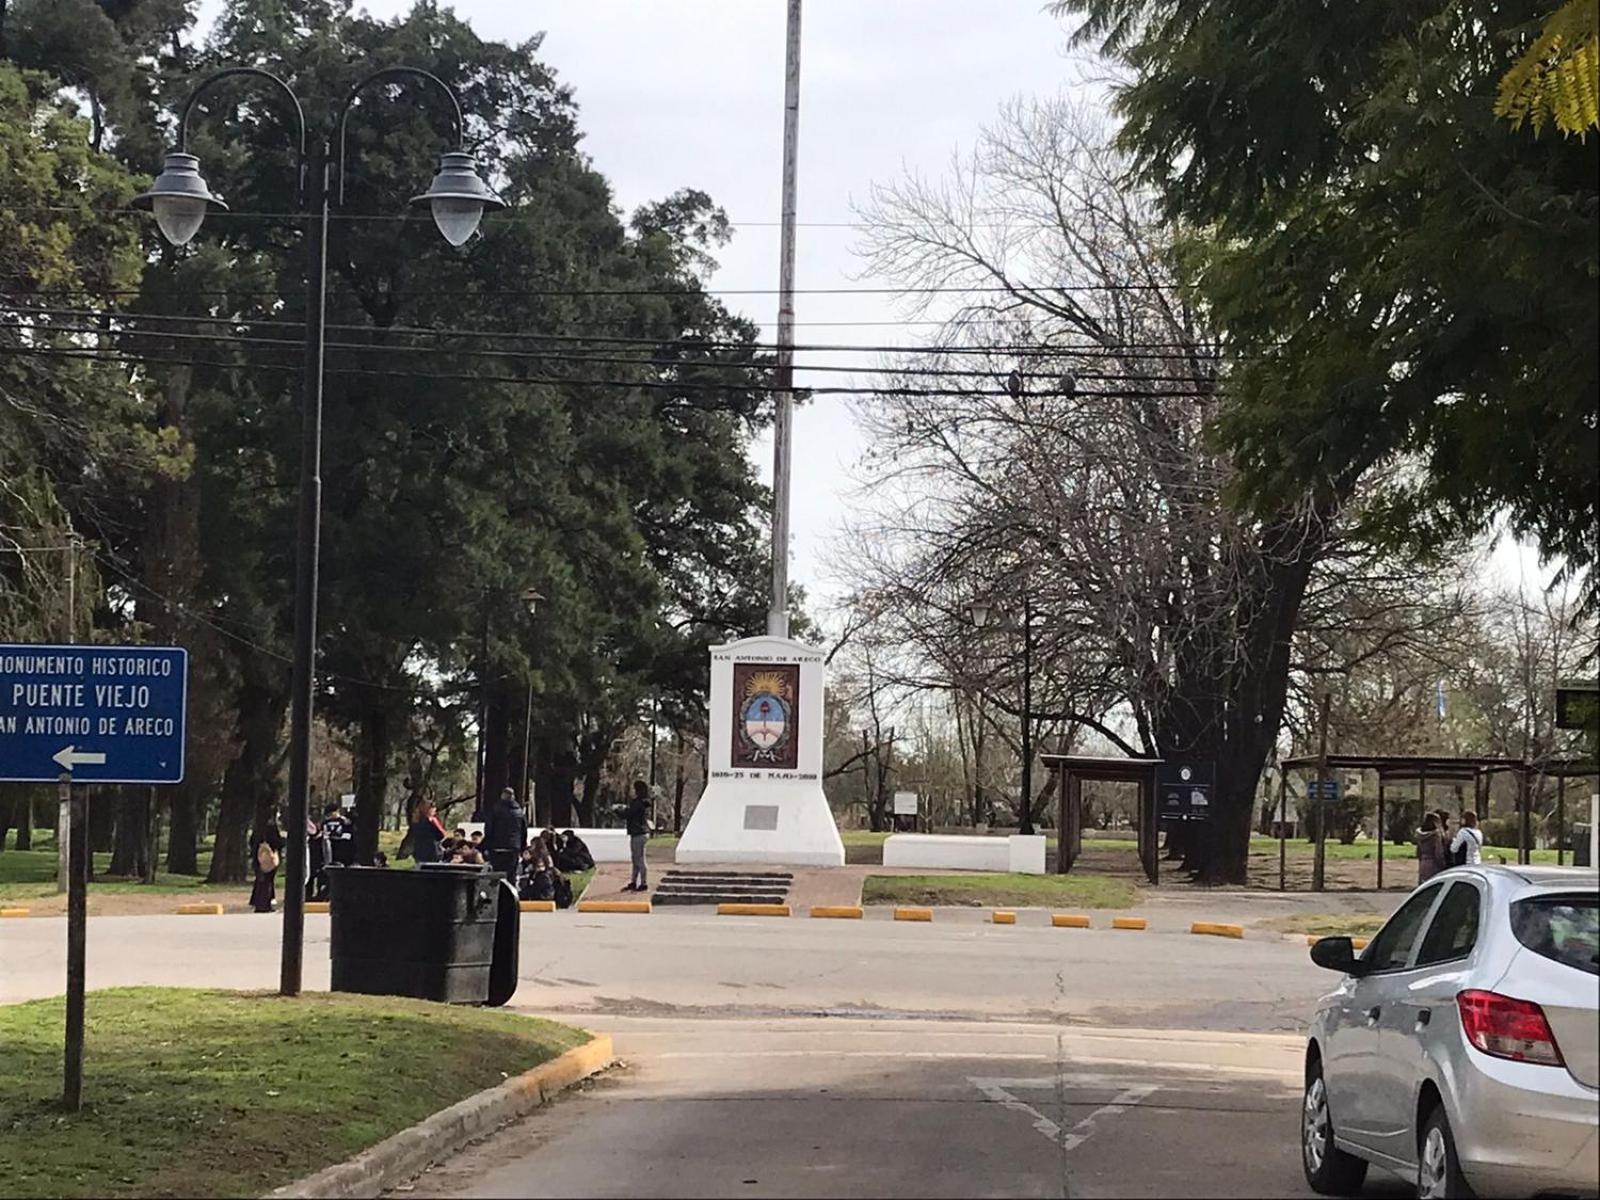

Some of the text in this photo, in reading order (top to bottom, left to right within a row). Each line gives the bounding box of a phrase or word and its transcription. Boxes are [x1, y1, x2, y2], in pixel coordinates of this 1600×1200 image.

[92, 657, 171, 677] HISTORICO
[12, 683, 150, 708] PUENTE VIEJO
[0, 716, 174, 736] AN ANTONIO DE ARECO
